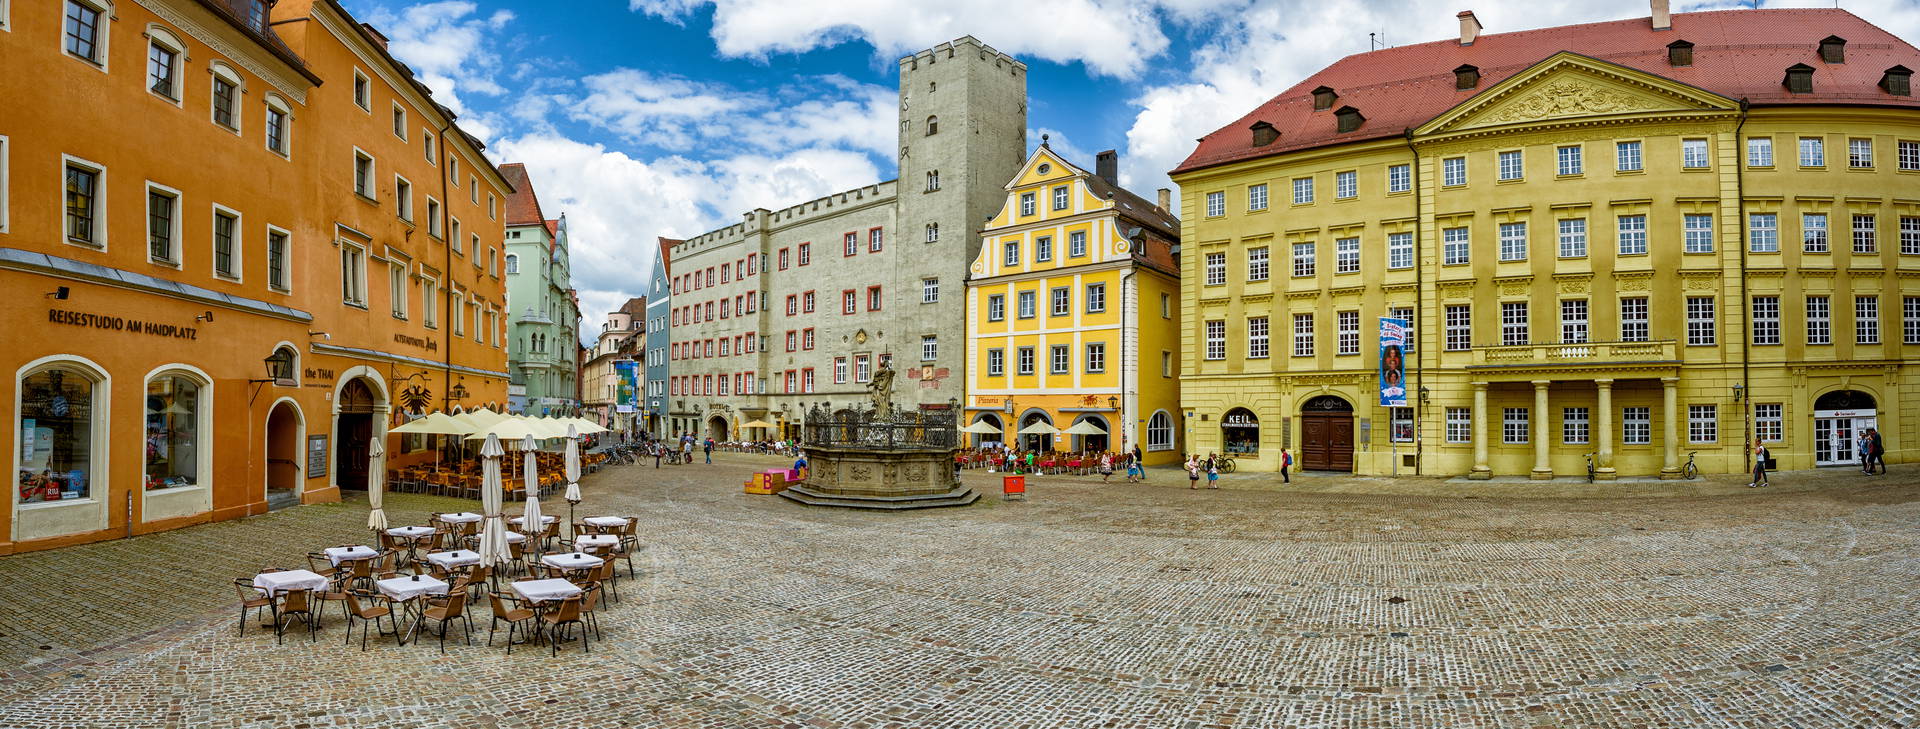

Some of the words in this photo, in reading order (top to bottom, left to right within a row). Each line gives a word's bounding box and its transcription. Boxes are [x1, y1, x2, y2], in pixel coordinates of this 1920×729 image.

[49, 309, 123, 330] REISESTUDIO
[126, 319, 142, 333] AM
[144, 322, 197, 340] HAIDPLATZ
[305, 368, 316, 378] the
[317, 369, 334, 379] THAI
[1229, 415, 1250, 423] KEIL
[763, 473, 771, 489] B
